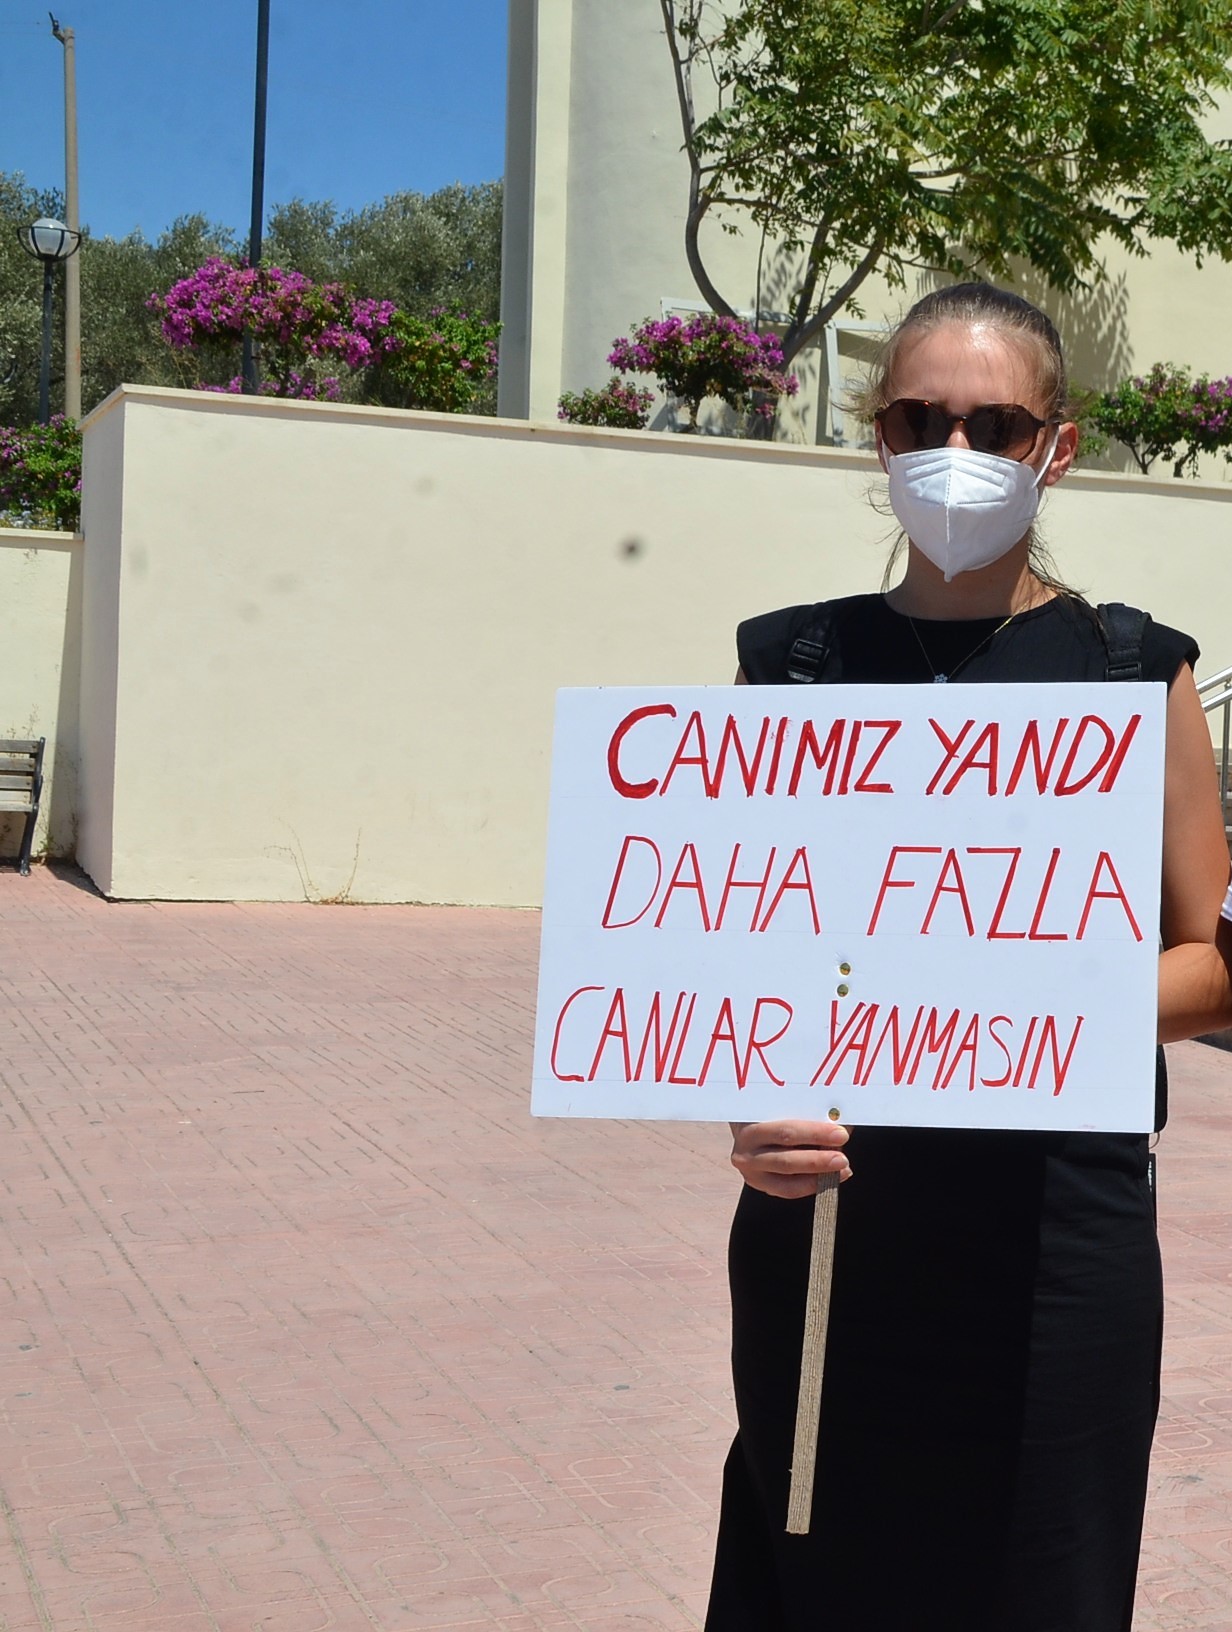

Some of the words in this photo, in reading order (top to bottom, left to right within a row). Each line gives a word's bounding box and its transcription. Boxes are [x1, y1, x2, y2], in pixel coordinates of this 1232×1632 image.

[607, 704, 902, 799] CANIMIZ
[926, 714, 1142, 797] YANDI
[601, 836, 820, 935] DAHA
[867, 846, 1143, 941] FAZLA
[551, 986, 793, 1089] CANLAR
[810, 995, 1084, 1096] YANMASIN
